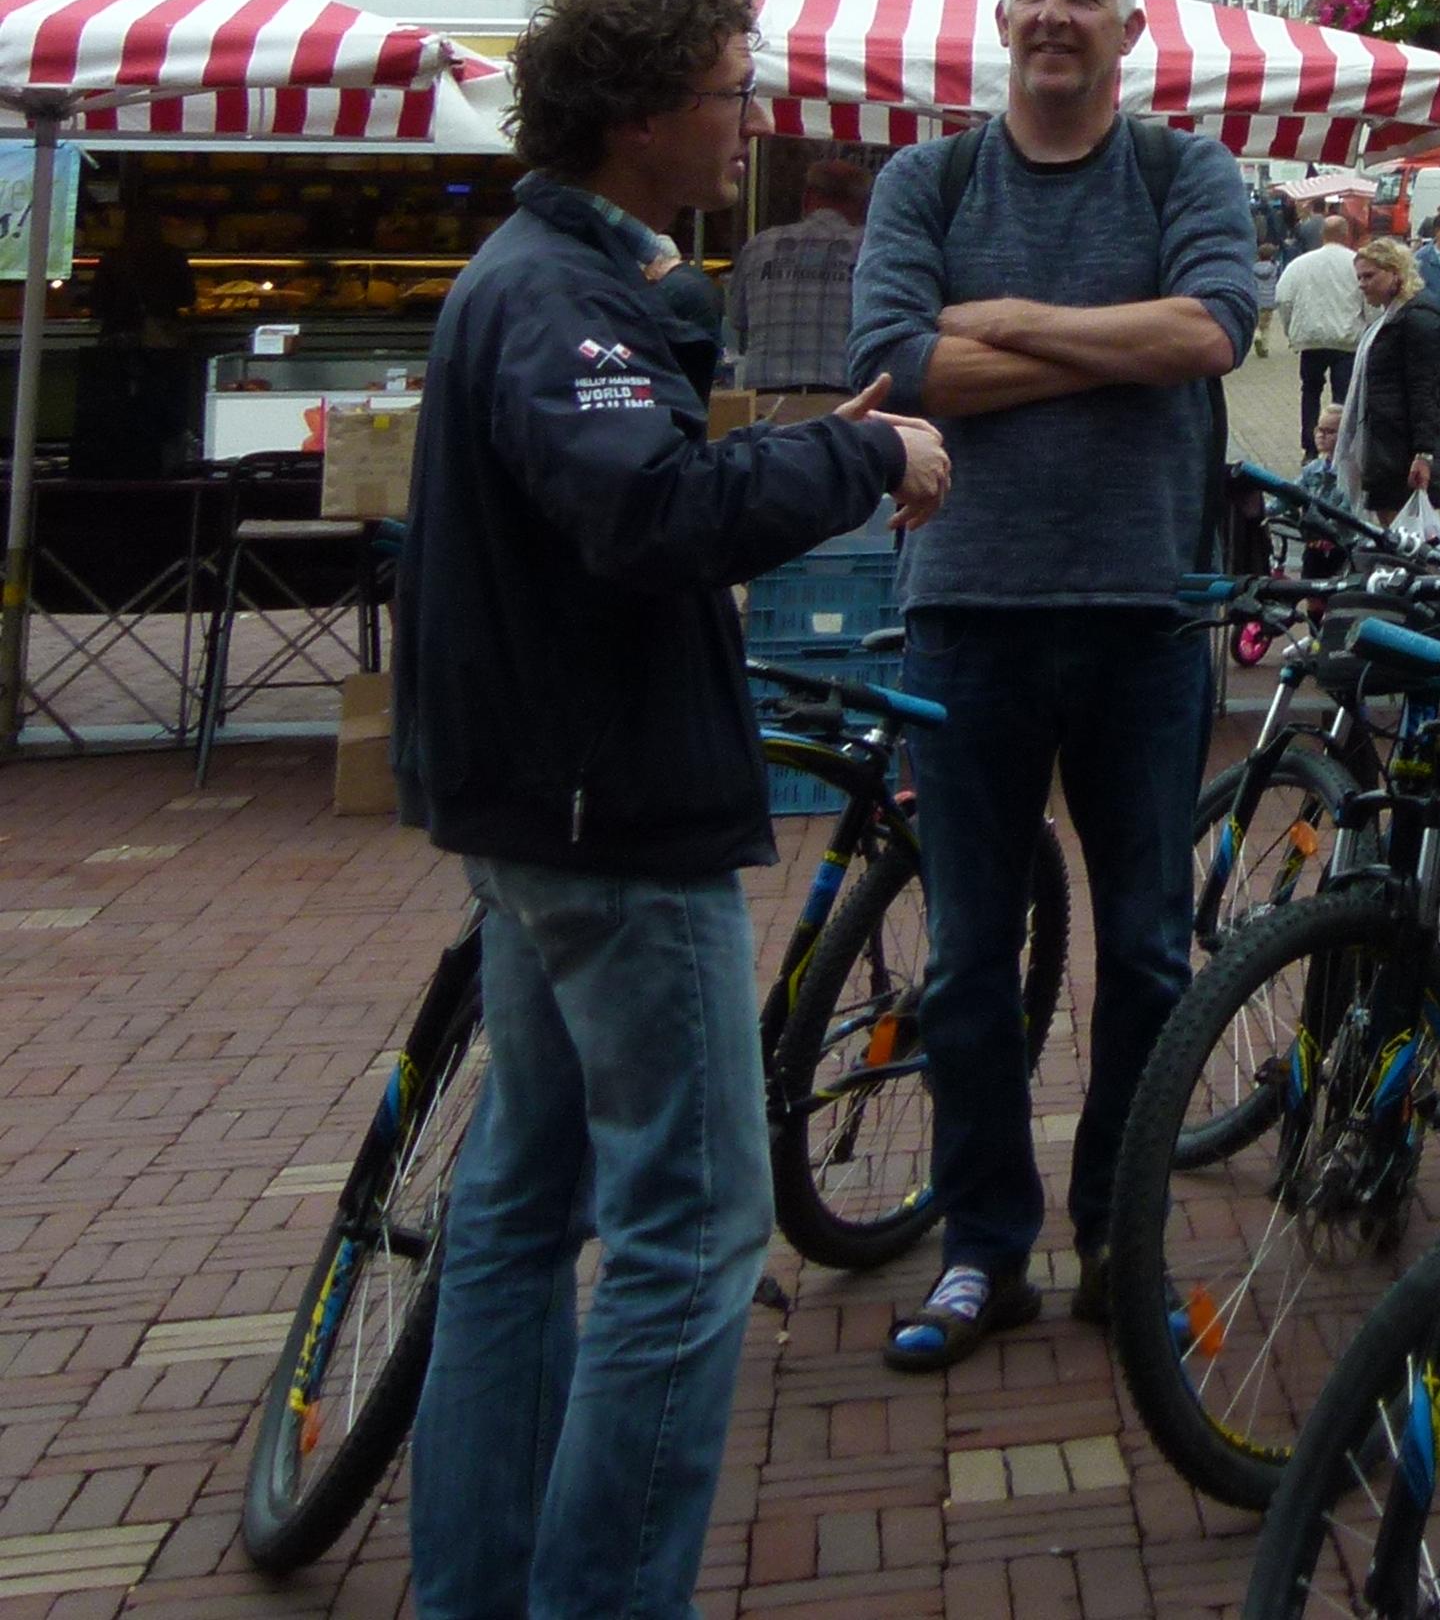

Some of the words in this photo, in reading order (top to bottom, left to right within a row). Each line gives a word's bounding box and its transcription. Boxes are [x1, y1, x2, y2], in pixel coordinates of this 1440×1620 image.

[575, 377, 606, 387] HELLY
[609, 376, 651, 386] HANSEN
[577, 387, 632, 402] WORLD
